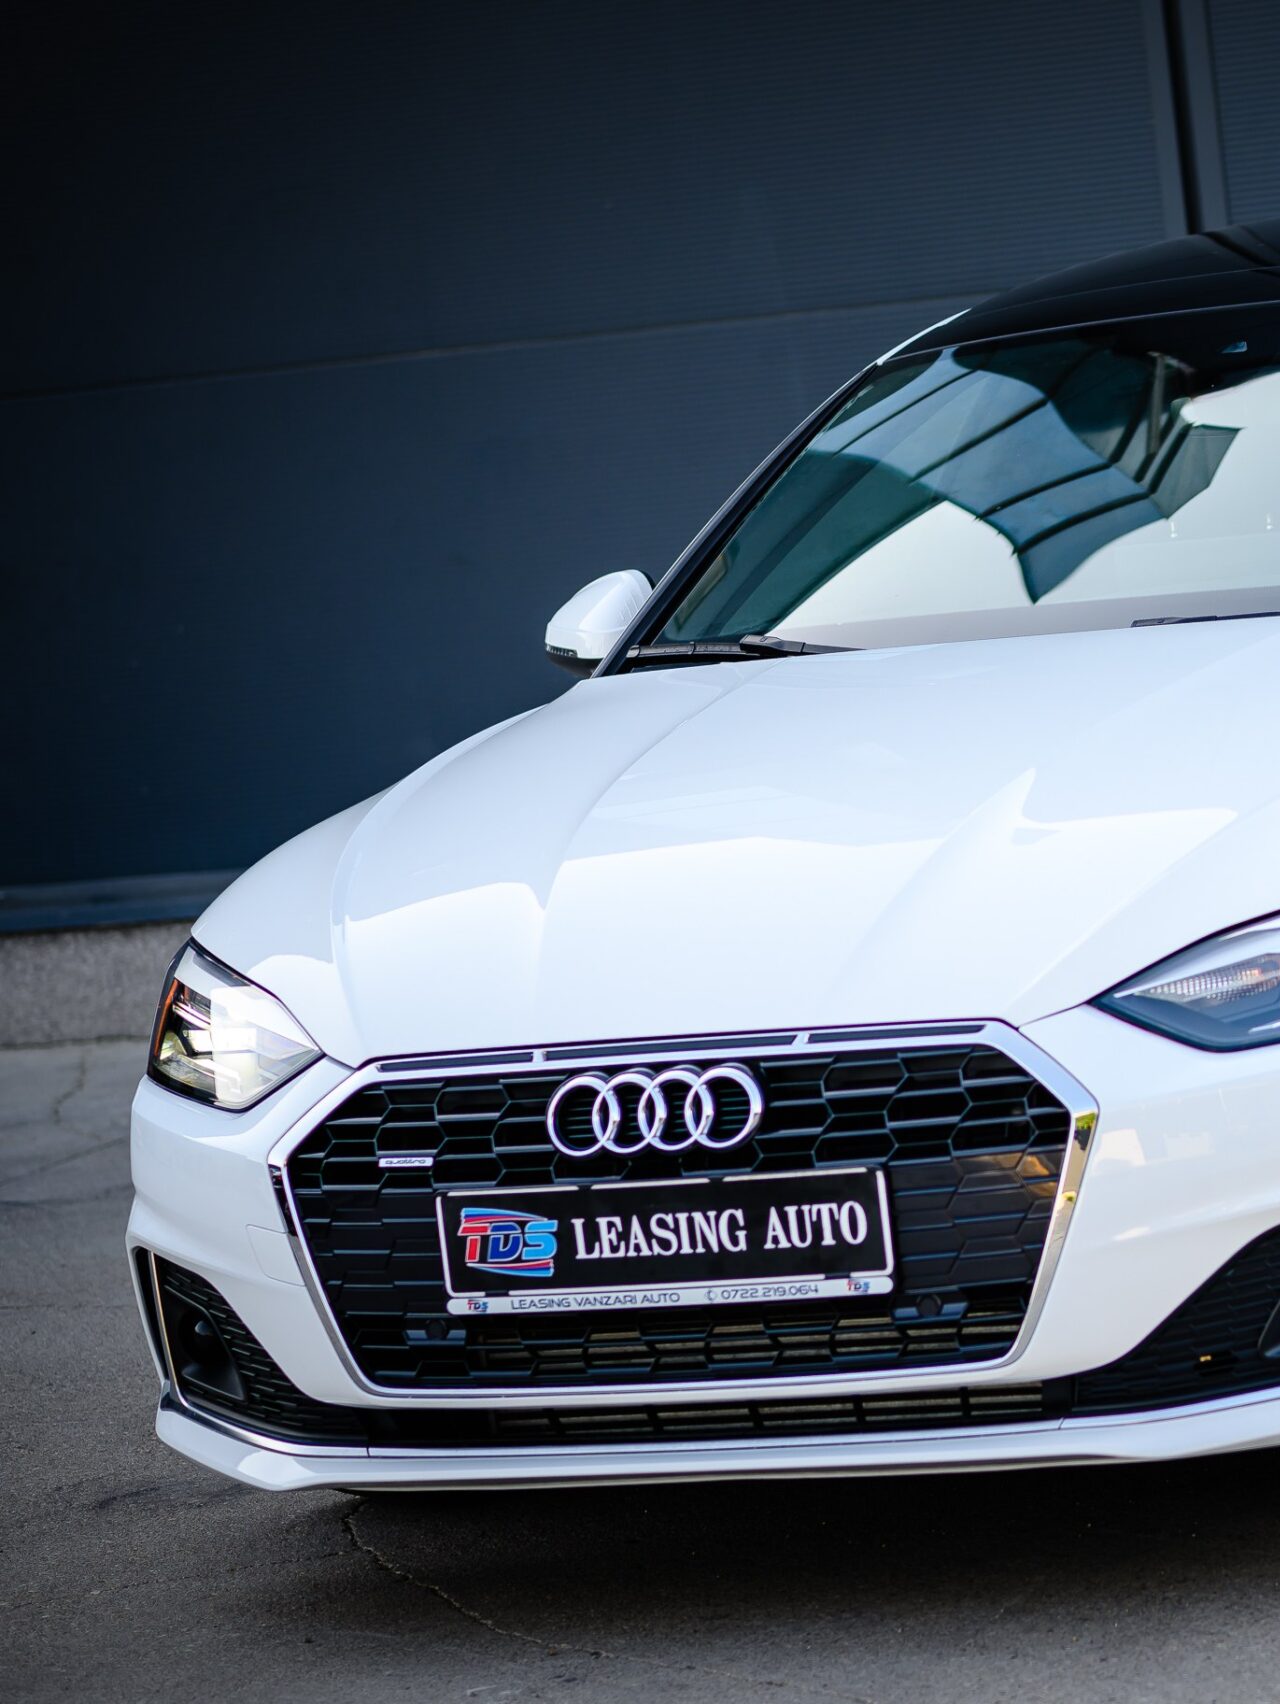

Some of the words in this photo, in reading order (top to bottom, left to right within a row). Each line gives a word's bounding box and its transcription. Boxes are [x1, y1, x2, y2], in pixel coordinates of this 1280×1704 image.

[457, 1219, 558, 1263] TDS
[570, 1208, 748, 1260] LEASING
[763, 1200, 868, 1250] AUTO
[467, 1299, 489, 1313] TDS
[510, 1297, 572, 1311] LEASING
[573, 1294, 638, 1308] VANZARI
[640, 1292, 681, 1305] AUTO
